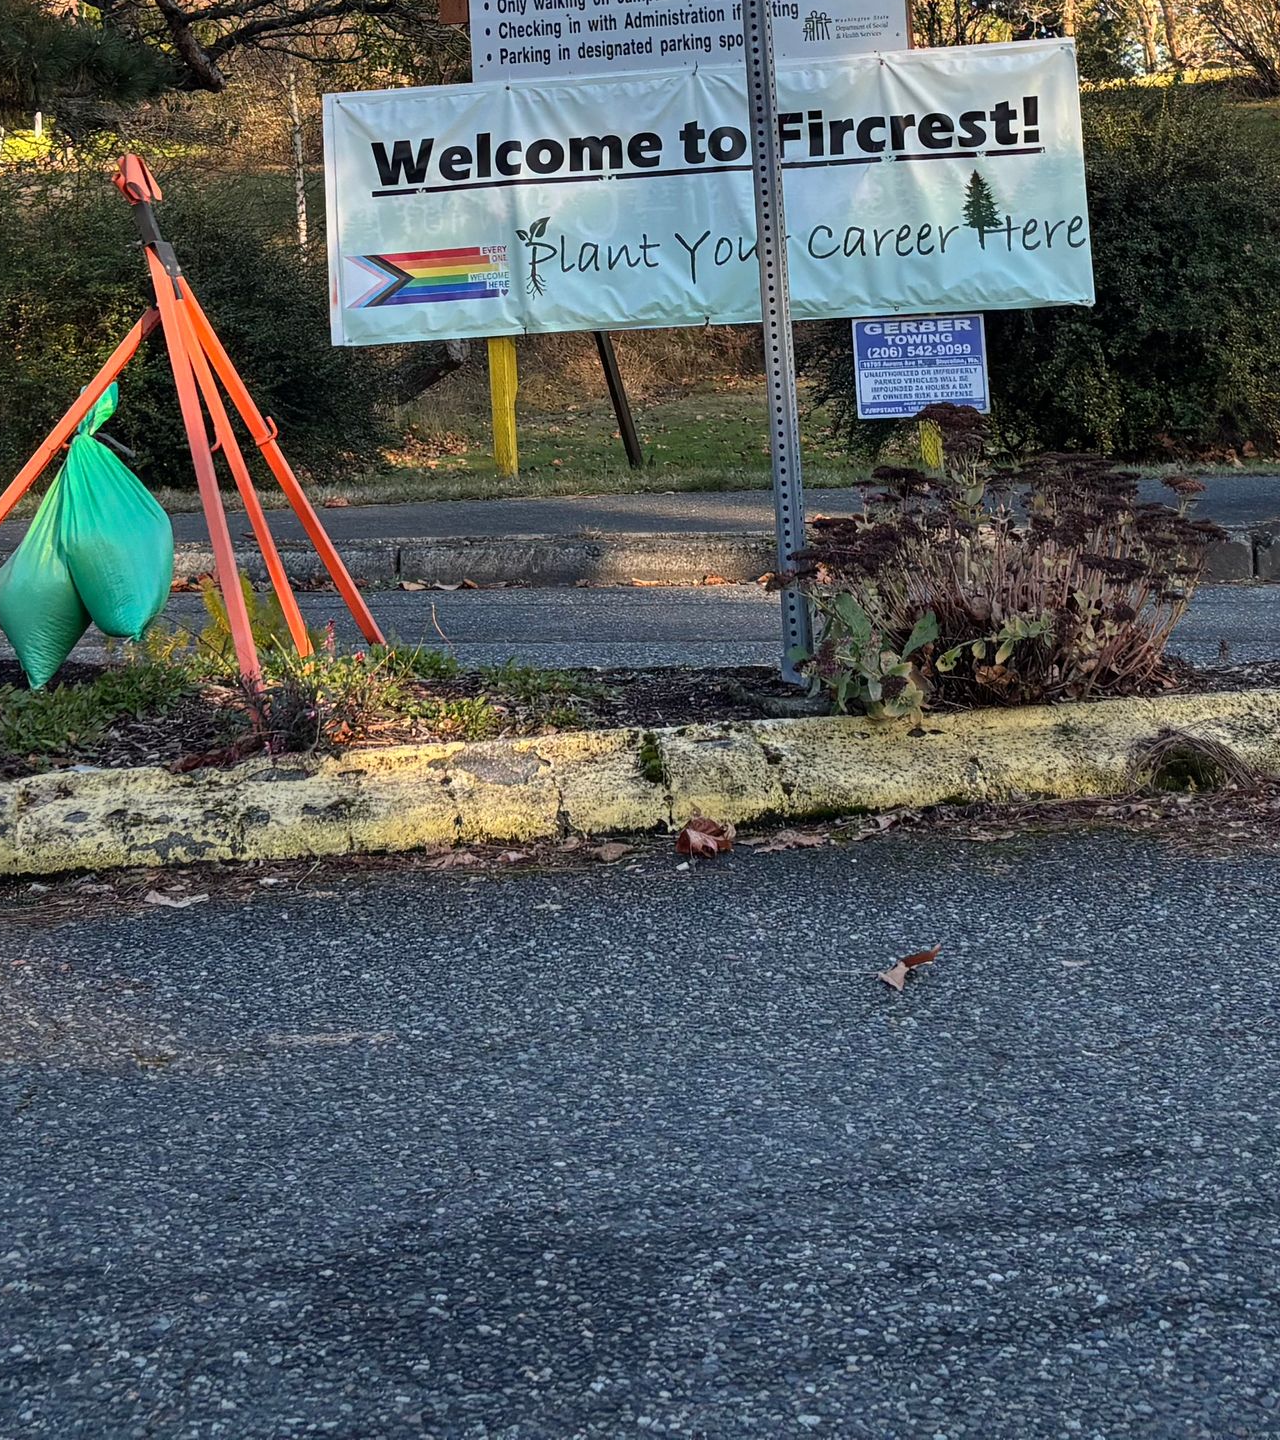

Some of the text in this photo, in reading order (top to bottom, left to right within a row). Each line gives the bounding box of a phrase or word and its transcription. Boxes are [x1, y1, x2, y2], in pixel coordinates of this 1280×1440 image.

[498, 18, 561, 39] Checking
[569, 16, 581, 34] in
[588, 15, 617, 32] with
[624, 6, 725, 30] Administration
[732, 3, 741, 21] if
[500, 46, 551, 65] Parking
[558, 44, 570, 61] in
[577, 37, 652, 61] designated
[660, 33, 712, 56] parking
[371, 95, 1040, 187] Welcome to Fircrest!
[482, 245, 507, 254] EVERY
[526, 214, 1087, 290] Plant You Career Here
[491, 254, 508, 263] ONE
[469, 271, 510, 281] WELCOME
[488, 280, 510, 289] HERE
[863, 319, 972, 335] GERBER
[884, 333, 953, 346] TOWING
[867, 343, 972, 359] (206) 542-9099
[863, 367, 978, 378] UNAUTHORIZED OR IMPROPERLY
[874, 378, 902, 386] PARKED
[903, 377, 939, 385] VEHICLES
[871, 385, 913, 393] IMPOUNDED
[872, 393, 881, 401] AT
[882, 392, 913, 400] OWNERS
[940, 390, 974, 398] EXPENSE
